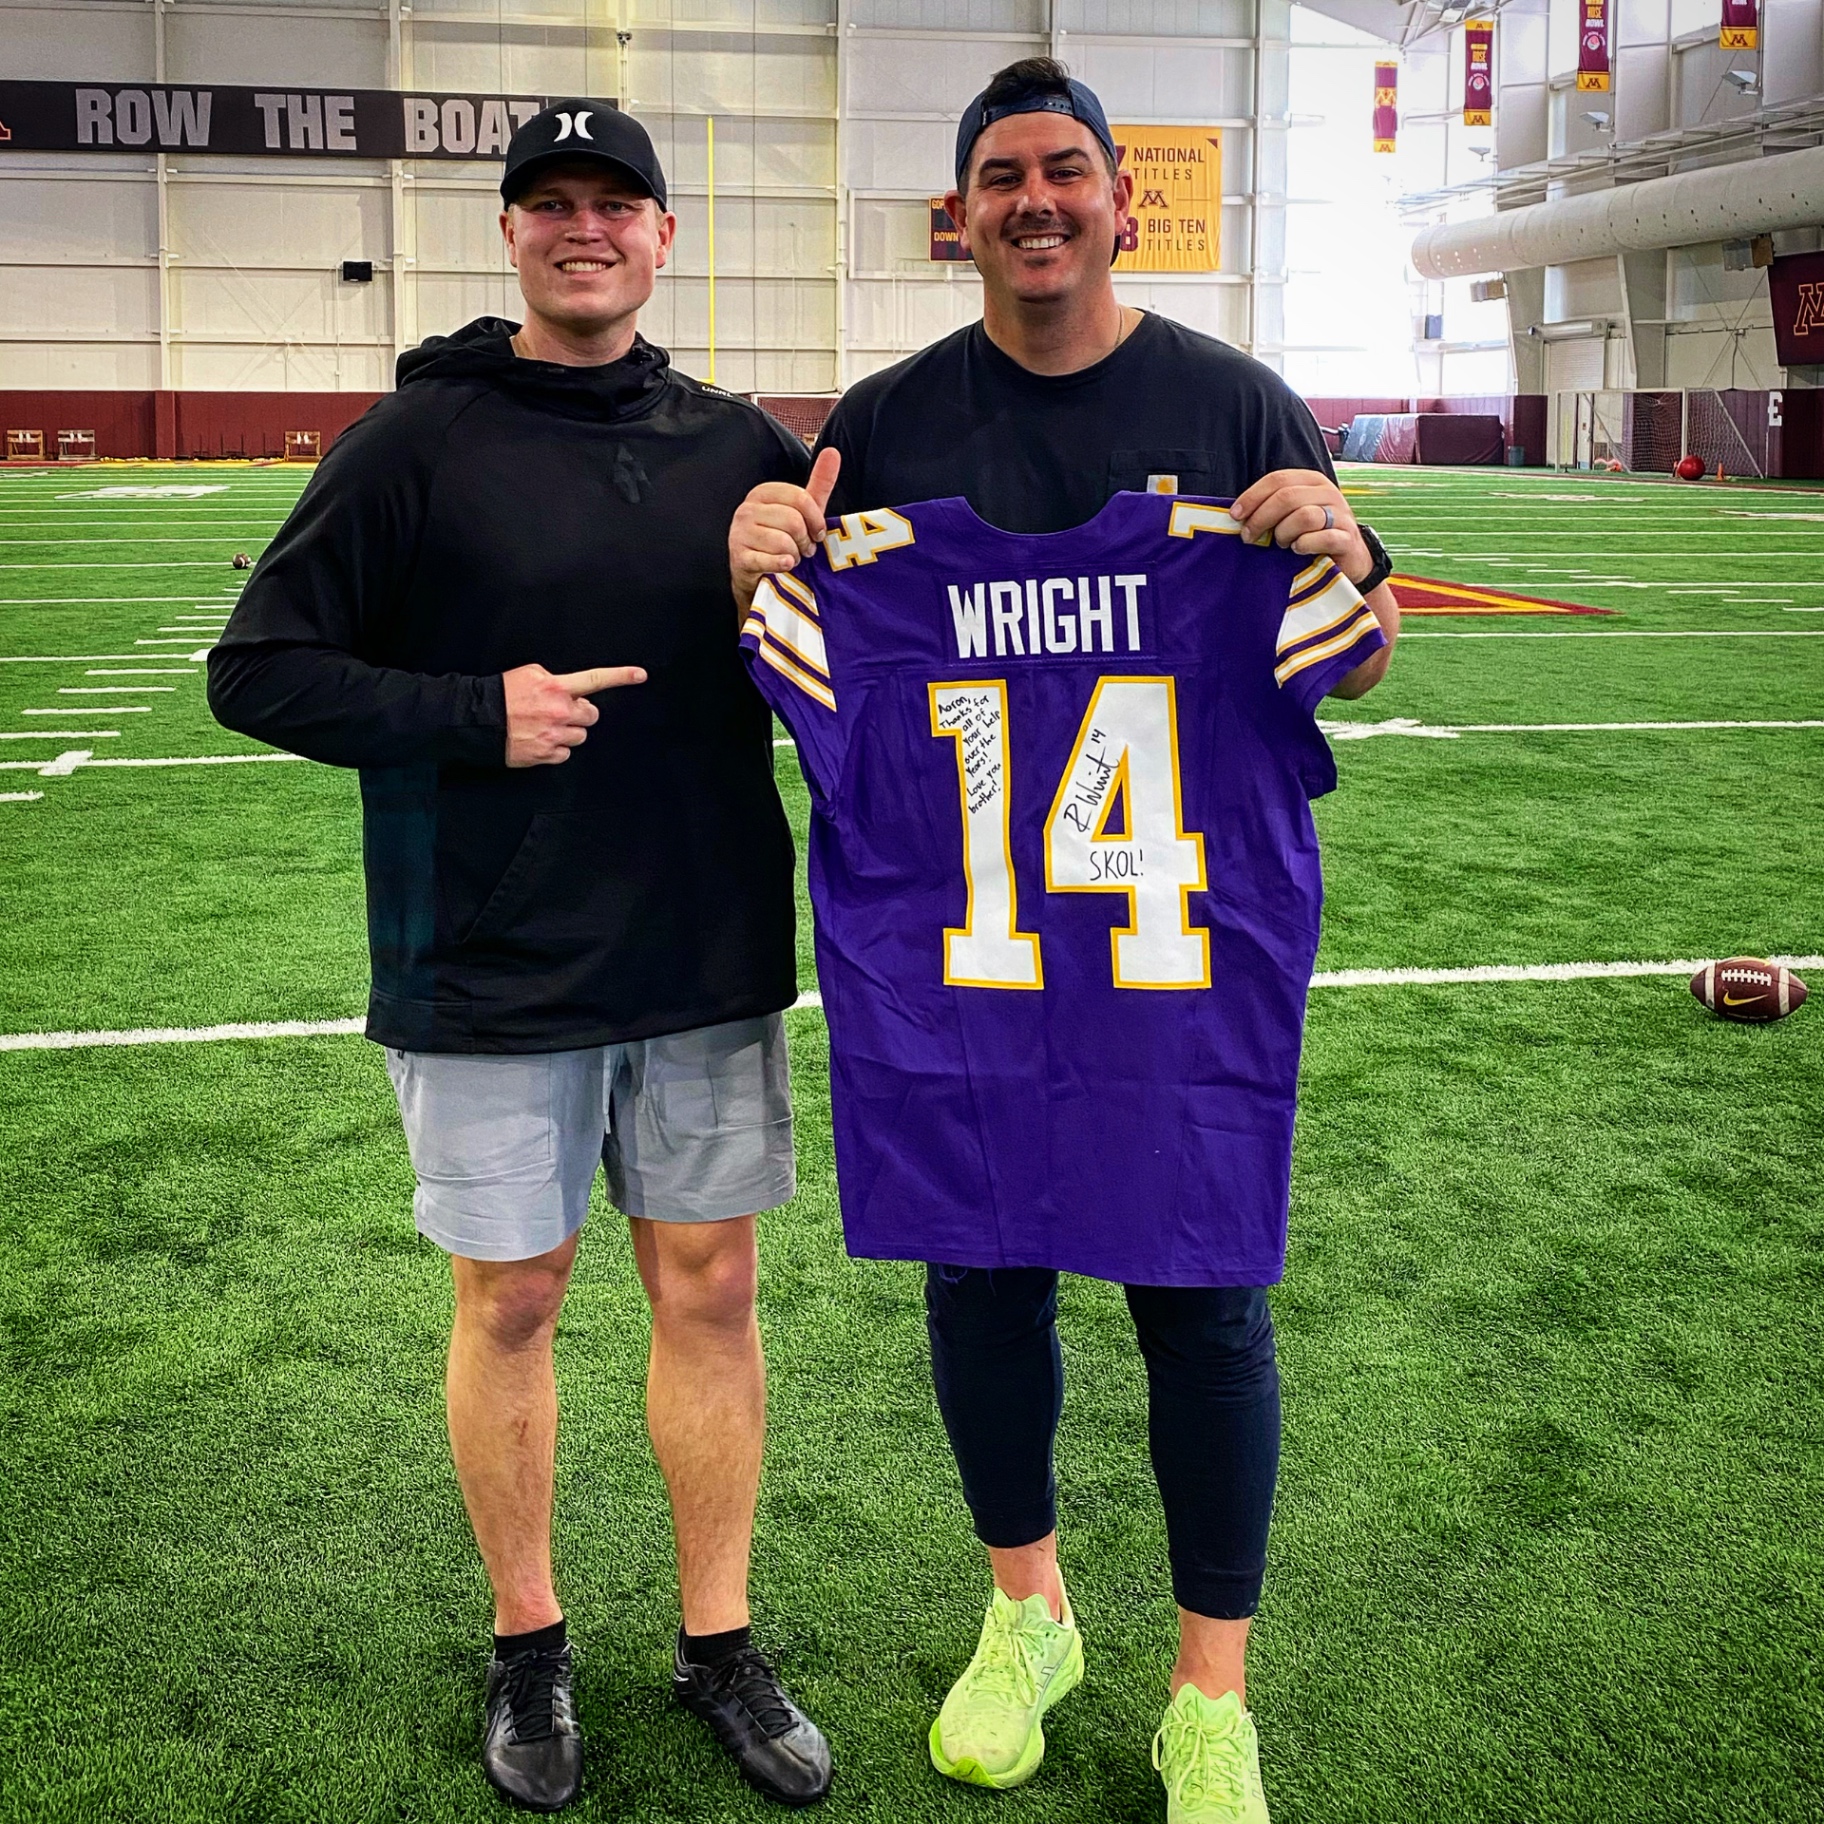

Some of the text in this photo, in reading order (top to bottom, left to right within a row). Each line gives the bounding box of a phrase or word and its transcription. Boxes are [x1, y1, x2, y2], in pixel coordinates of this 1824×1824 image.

[75, 88, 213, 147] ROW
[254, 93, 357, 151] THE
[1133, 146, 1205, 163] NATIONAL
[1133, 167, 1193, 181] TITLES
[933, 231, 959, 242] DOWN
[1147, 218, 1171, 234] BIG
[1179, 218, 1206, 234] TEN
[1147, 239, 1206, 252] TITLES
[947, 574, 1147, 658] WRIGHT
[939, 695, 989, 728] Thanks for
[962, 708, 985, 732] all of
[982, 710, 1000, 728] help
[1090, 728, 1106, 744] 14
[965, 734, 996, 764] over the
[966, 780, 986, 797] Love
[968, 779, 1001, 814] brother!
[928, 676, 1212, 990] 14
[1089, 848, 1144, 881] SKOL!
